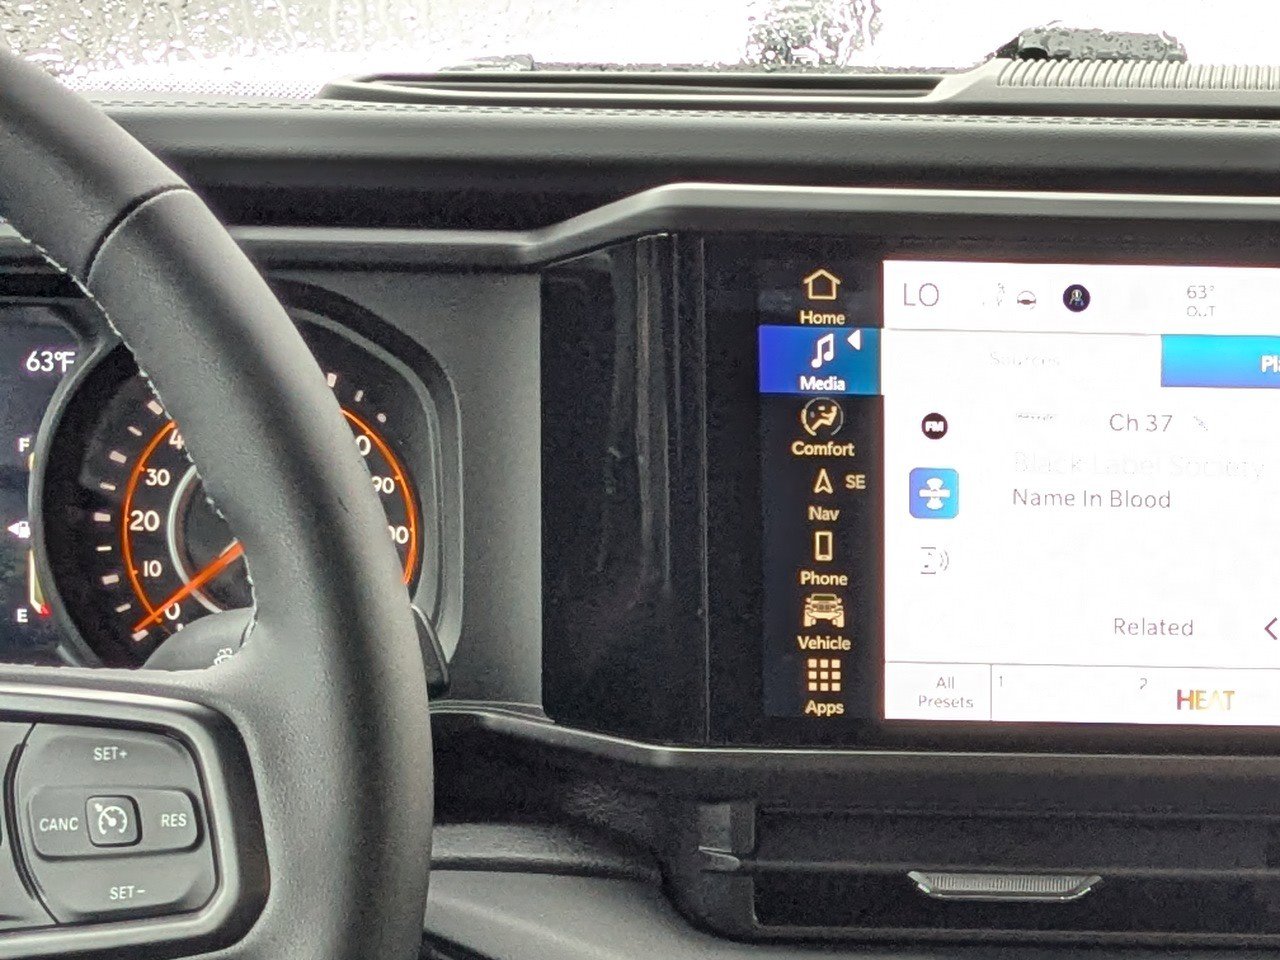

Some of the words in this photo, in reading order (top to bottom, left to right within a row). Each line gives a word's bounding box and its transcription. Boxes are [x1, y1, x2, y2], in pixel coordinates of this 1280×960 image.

[904, 282, 939, 307] LO
[800, 311, 846, 325] Home
[26, 350, 75, 373] 63°F
[800, 376, 846, 391] Media
[1109, 413, 1139, 432] Ch
[1146, 414, 1173, 433] 37
[18, 438, 30, 452] F
[168, 428, 185, 449] 4
[791, 441, 855, 457] Comfort
[145, 468, 171, 486] 30
[845, 474, 866, 489] SE
[1012, 487, 1076, 508] Name
[1084, 489, 1103, 508] In
[1110, 489, 1171, 509] Blood
[130, 509, 161, 532] 20
[808, 506, 840, 521] Nav
[143, 559, 163, 577] 10
[800, 571, 848, 586] Phone
[1113, 617, 1194, 636] Related
[797, 635, 852, 650] Vehicle
[935, 676, 955, 690] All
[805, 700, 844, 716] Apps
[917, 694, 974, 710] Presets
[1176, 689, 1235, 711] HEAT
[93, 746, 128, 761] SET+
[39, 817, 79, 832] CANC
[160, 813, 187, 827] RES
